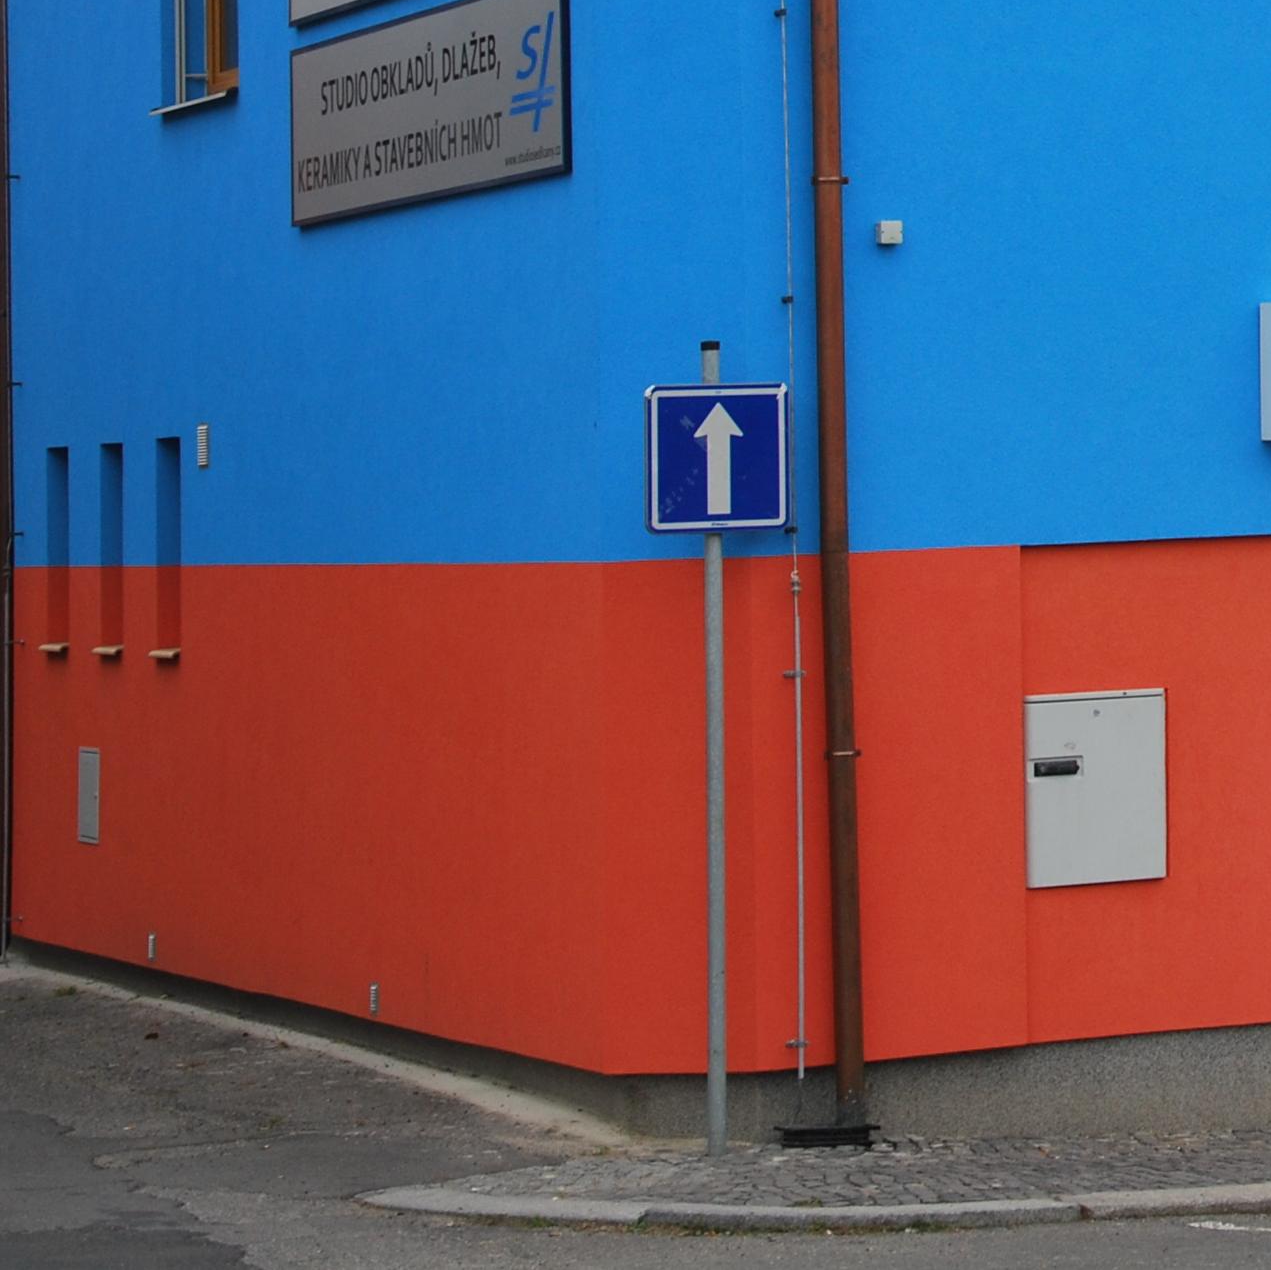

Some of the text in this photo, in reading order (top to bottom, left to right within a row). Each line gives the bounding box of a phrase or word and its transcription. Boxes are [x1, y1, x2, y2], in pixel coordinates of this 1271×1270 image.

[320, 31, 501, 116] STUDIO OBKLADŮ, DLAŽEB,
[297, 112, 502, 194] KERAMIKY A STAVEBNÍCH HMOT
